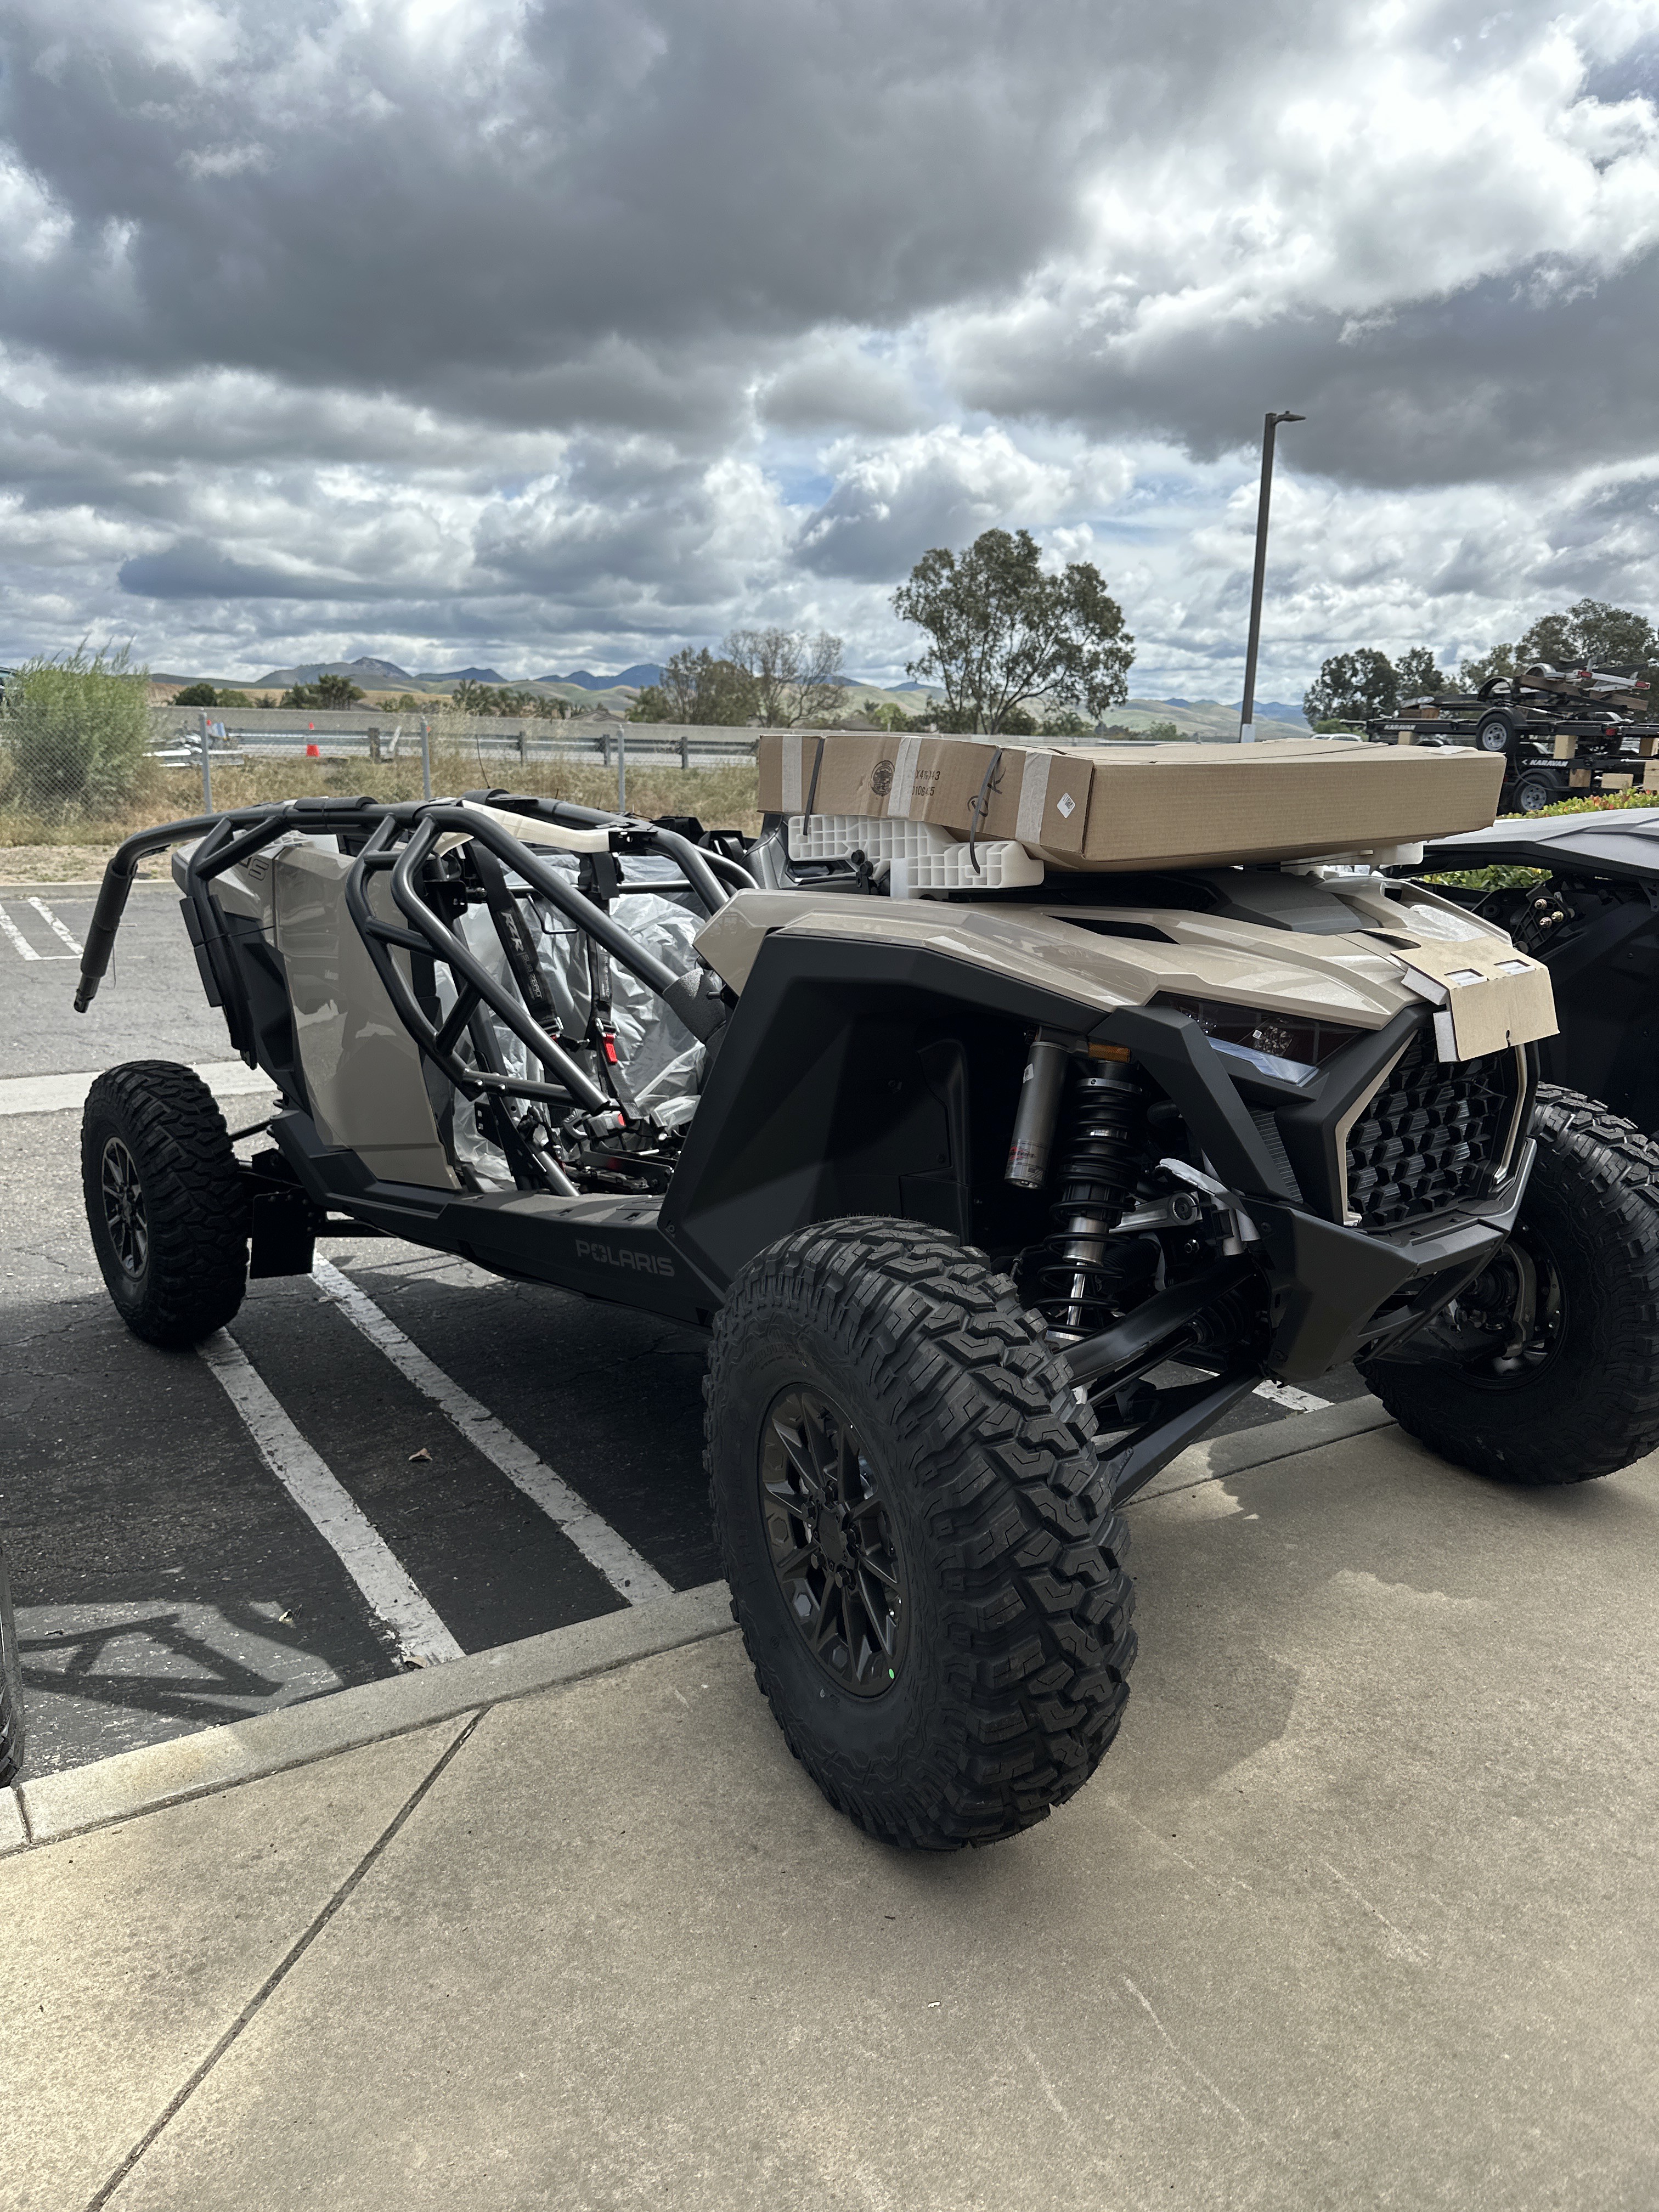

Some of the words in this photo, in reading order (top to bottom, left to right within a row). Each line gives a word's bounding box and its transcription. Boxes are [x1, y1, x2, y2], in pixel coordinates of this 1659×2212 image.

[1529, 759, 1569, 768] KARAVAN
[502, 912, 524, 952] RZR
[531, 973, 542, 998] ZERO
[575, 1239, 675, 1277] POLARIS
